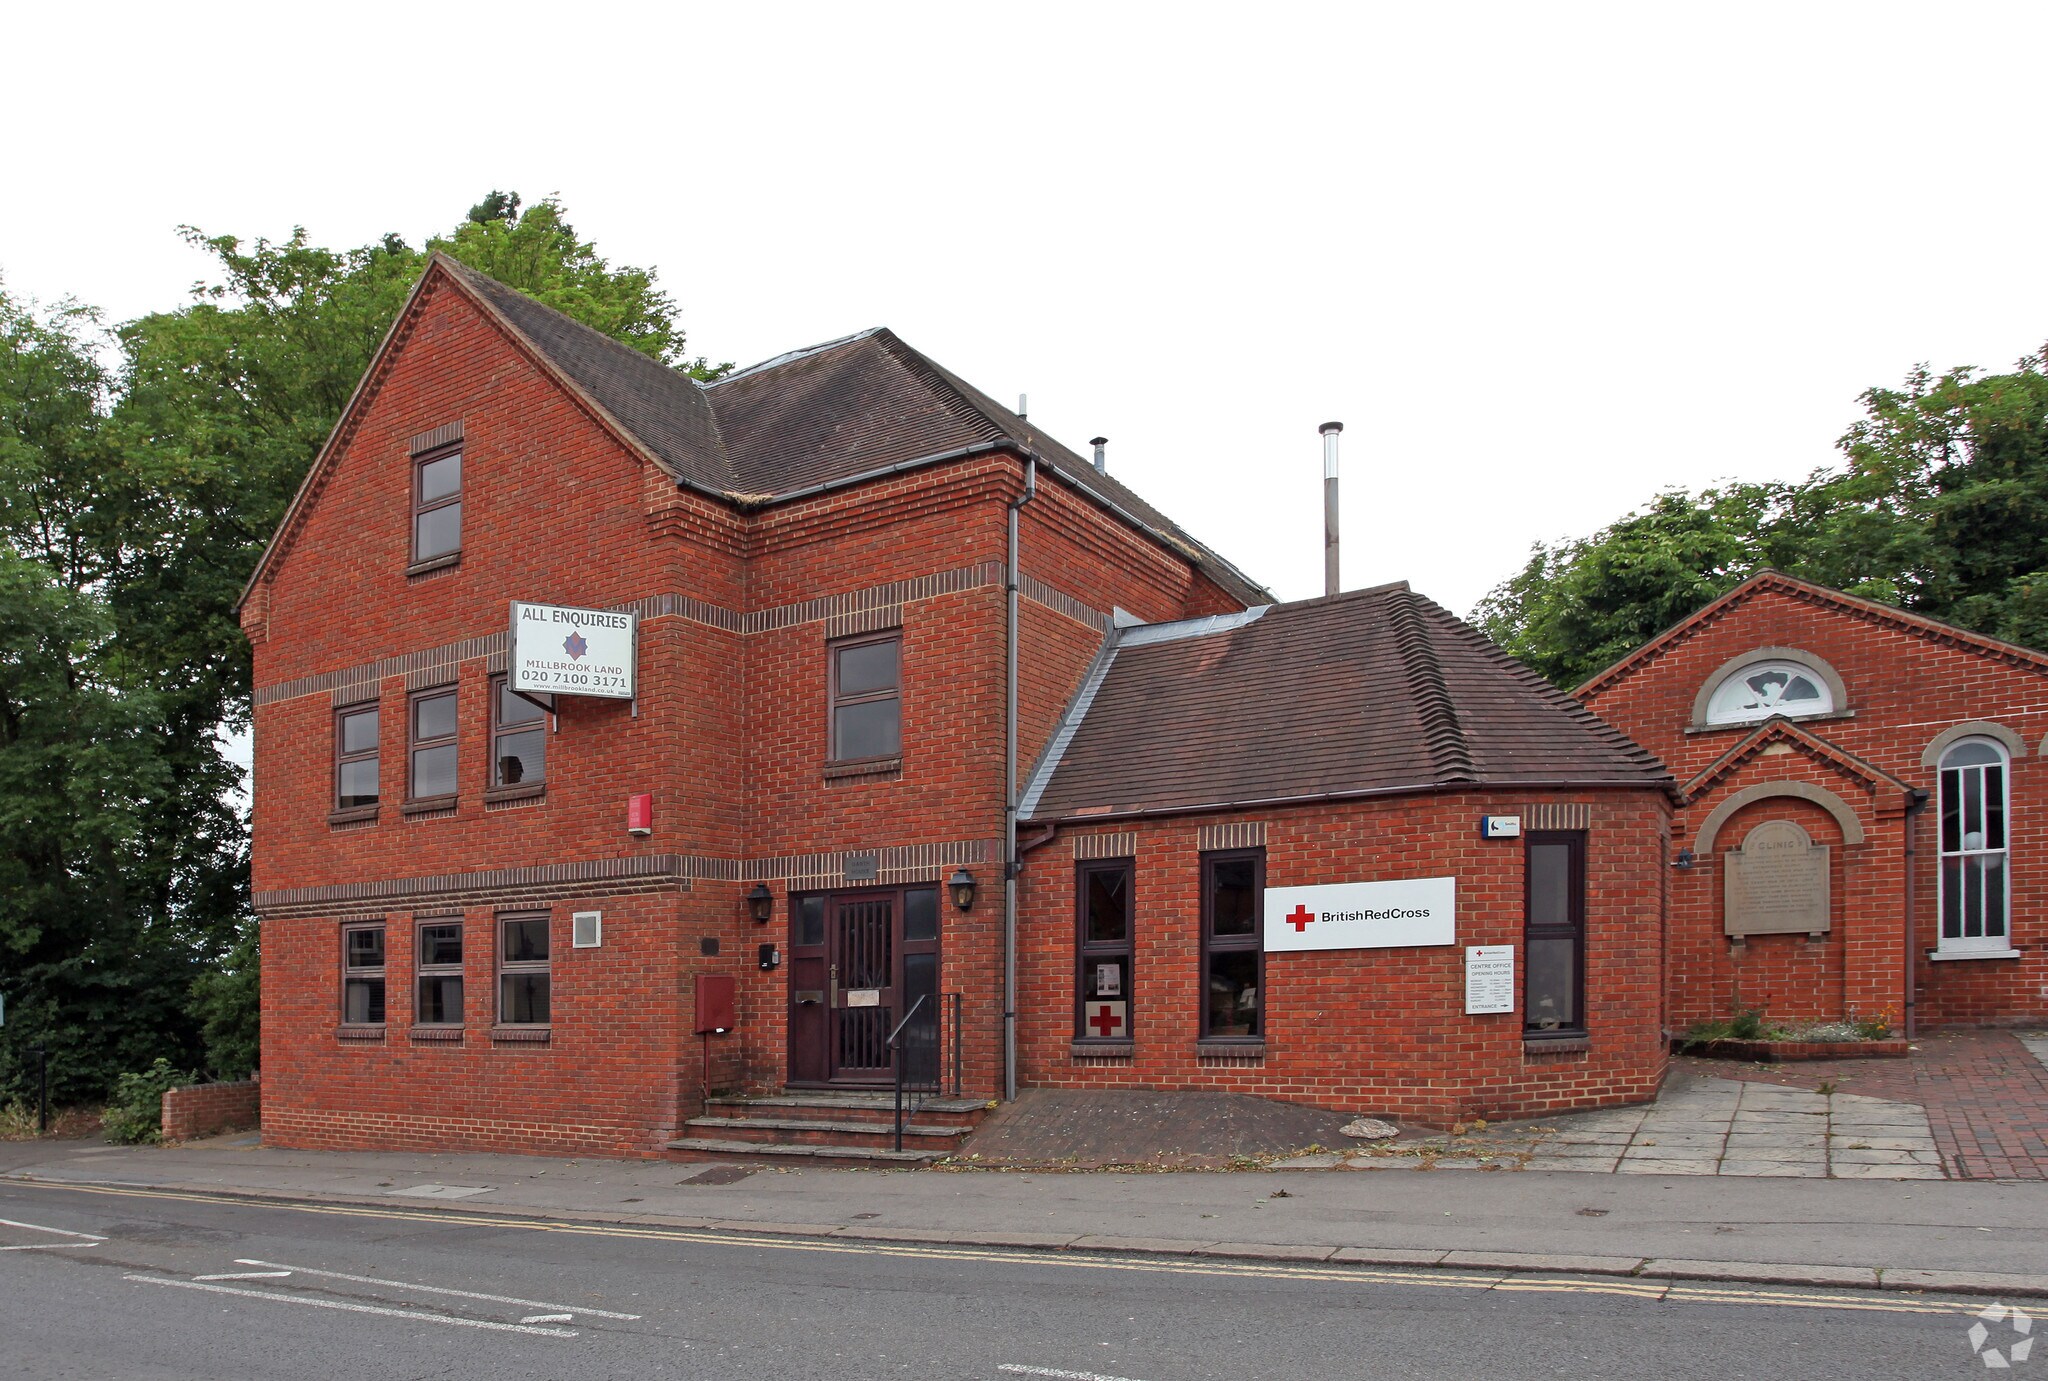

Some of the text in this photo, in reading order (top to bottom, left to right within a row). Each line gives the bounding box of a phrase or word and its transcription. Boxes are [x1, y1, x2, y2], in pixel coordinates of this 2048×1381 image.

[522, 607, 627, 630] ALL ENQUIRIES
[526, 659, 623, 675] MILLBROOK LAND
[521, 670, 626, 688] 020 7100 3171
[533, 683, 615, 694] www.millbrookland.co.uk
[1758, 840, 1794, 850] CLINIC
[1321, 908, 1430, 923] BritishRedCross
